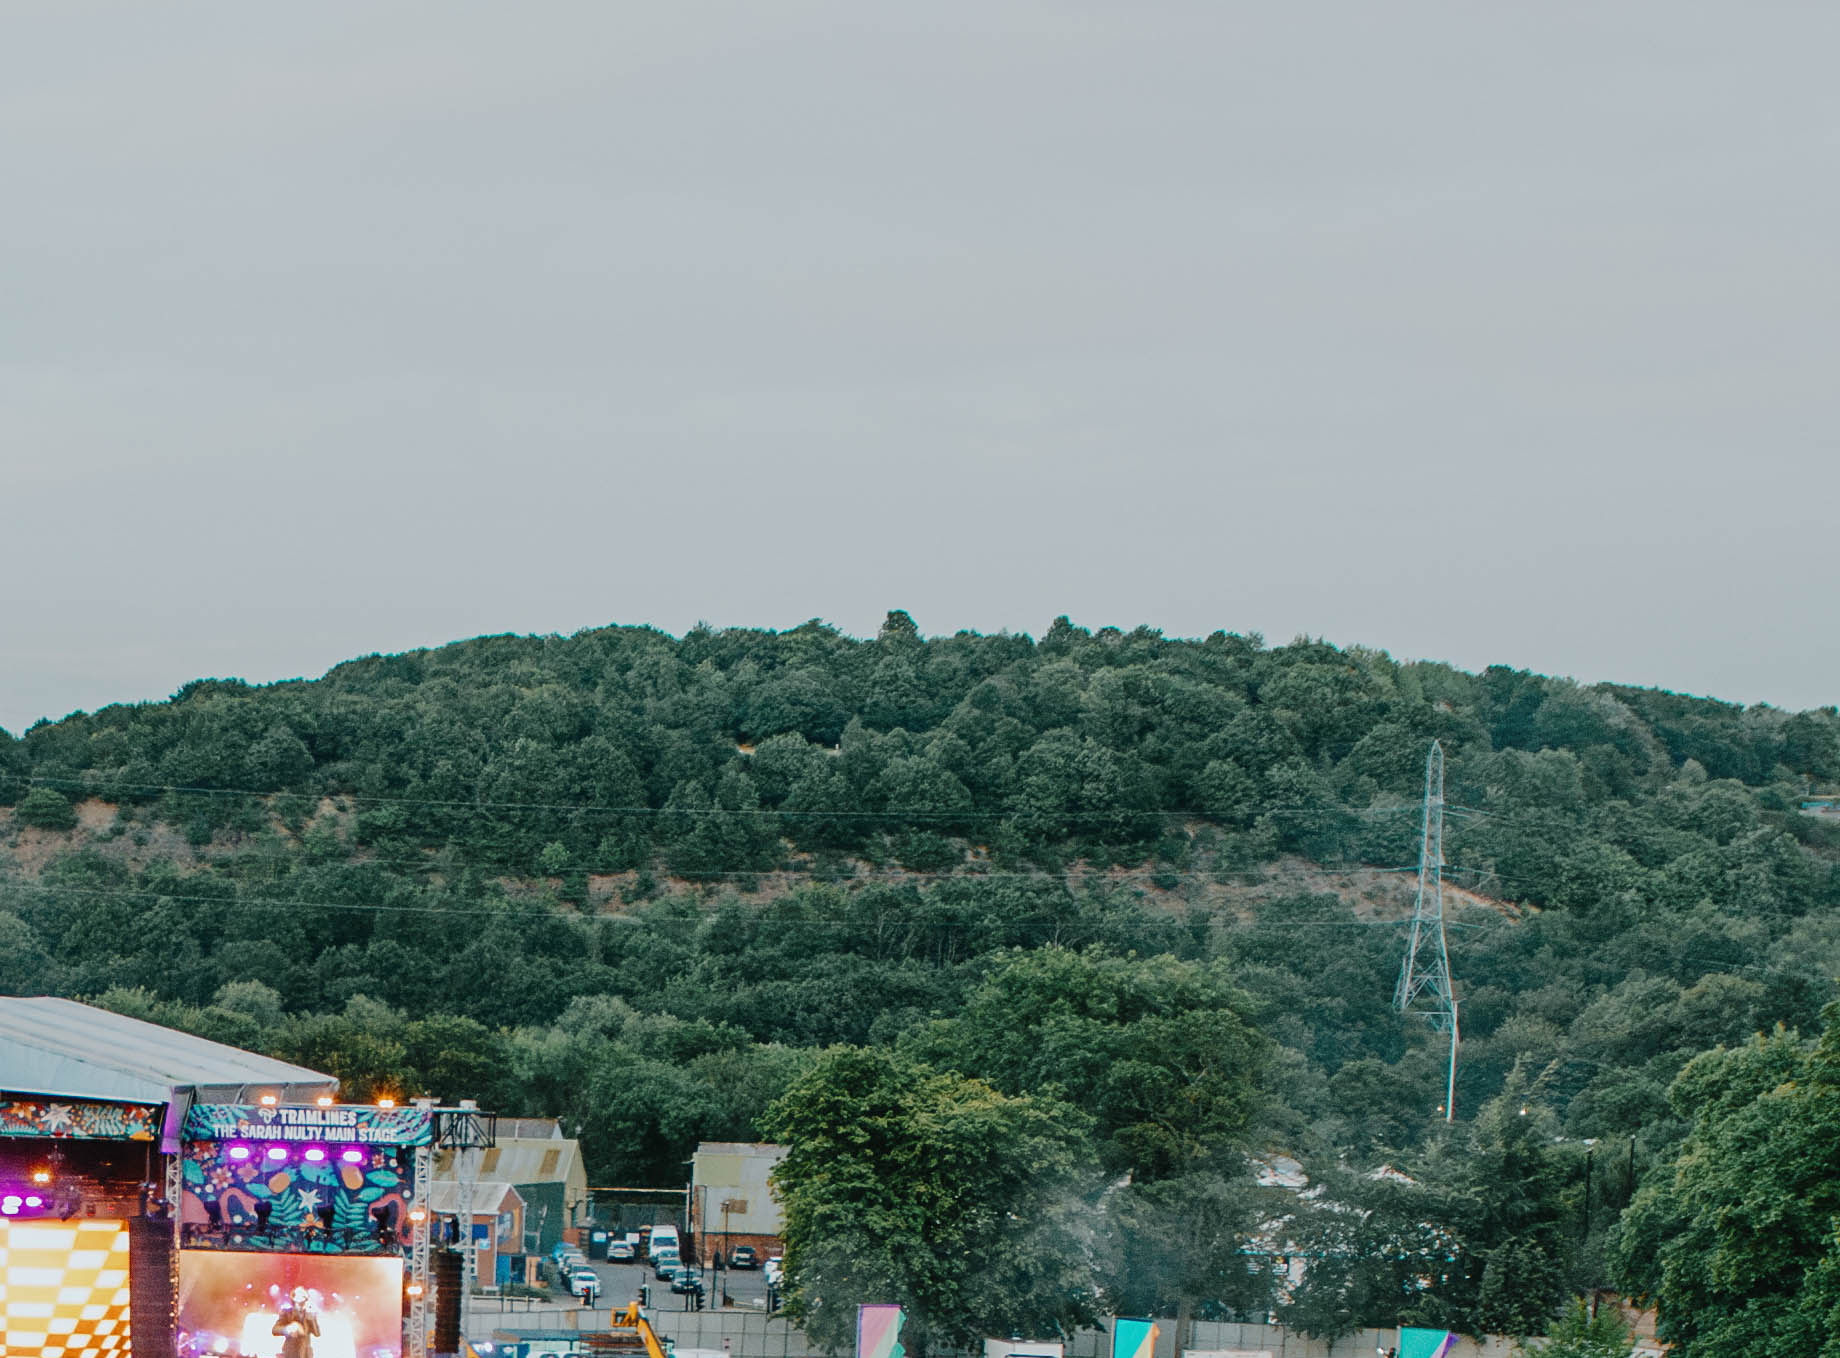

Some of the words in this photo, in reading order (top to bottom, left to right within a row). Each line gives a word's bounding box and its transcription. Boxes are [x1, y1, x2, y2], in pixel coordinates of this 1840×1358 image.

[280, 1109, 357, 1126] TRAMLINES
[214, 1124, 237, 1139] THE
[240, 1125, 281, 1140] SARAH
[284, 1126, 322, 1141] NULTY
[325, 1127, 356, 1142] MAIN
[359, 1127, 398, 1143] STAGE
